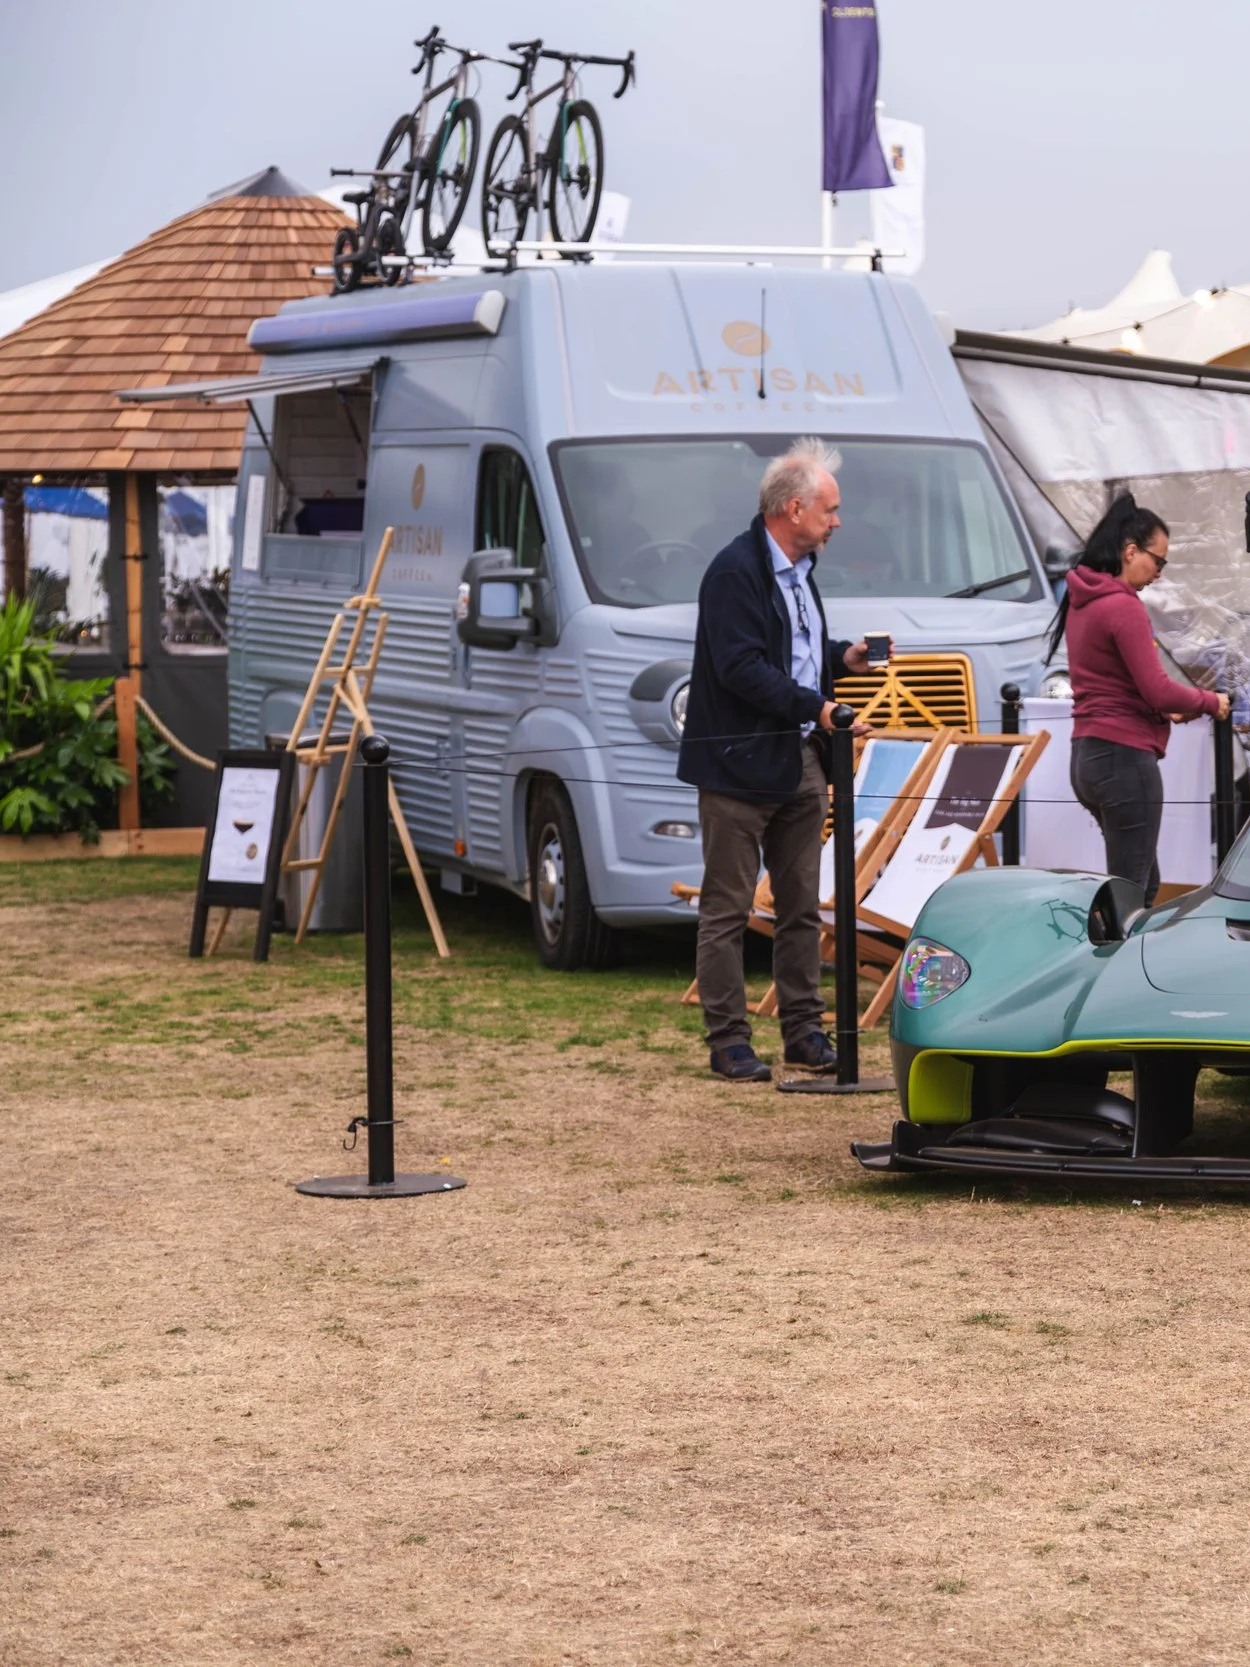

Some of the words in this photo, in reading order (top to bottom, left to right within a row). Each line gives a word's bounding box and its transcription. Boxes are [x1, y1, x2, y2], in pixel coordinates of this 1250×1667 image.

[653, 368, 864, 395] ARTISAN
[690, 402, 815, 412] COFFEE
[391, 525, 442, 556] RTISAN
